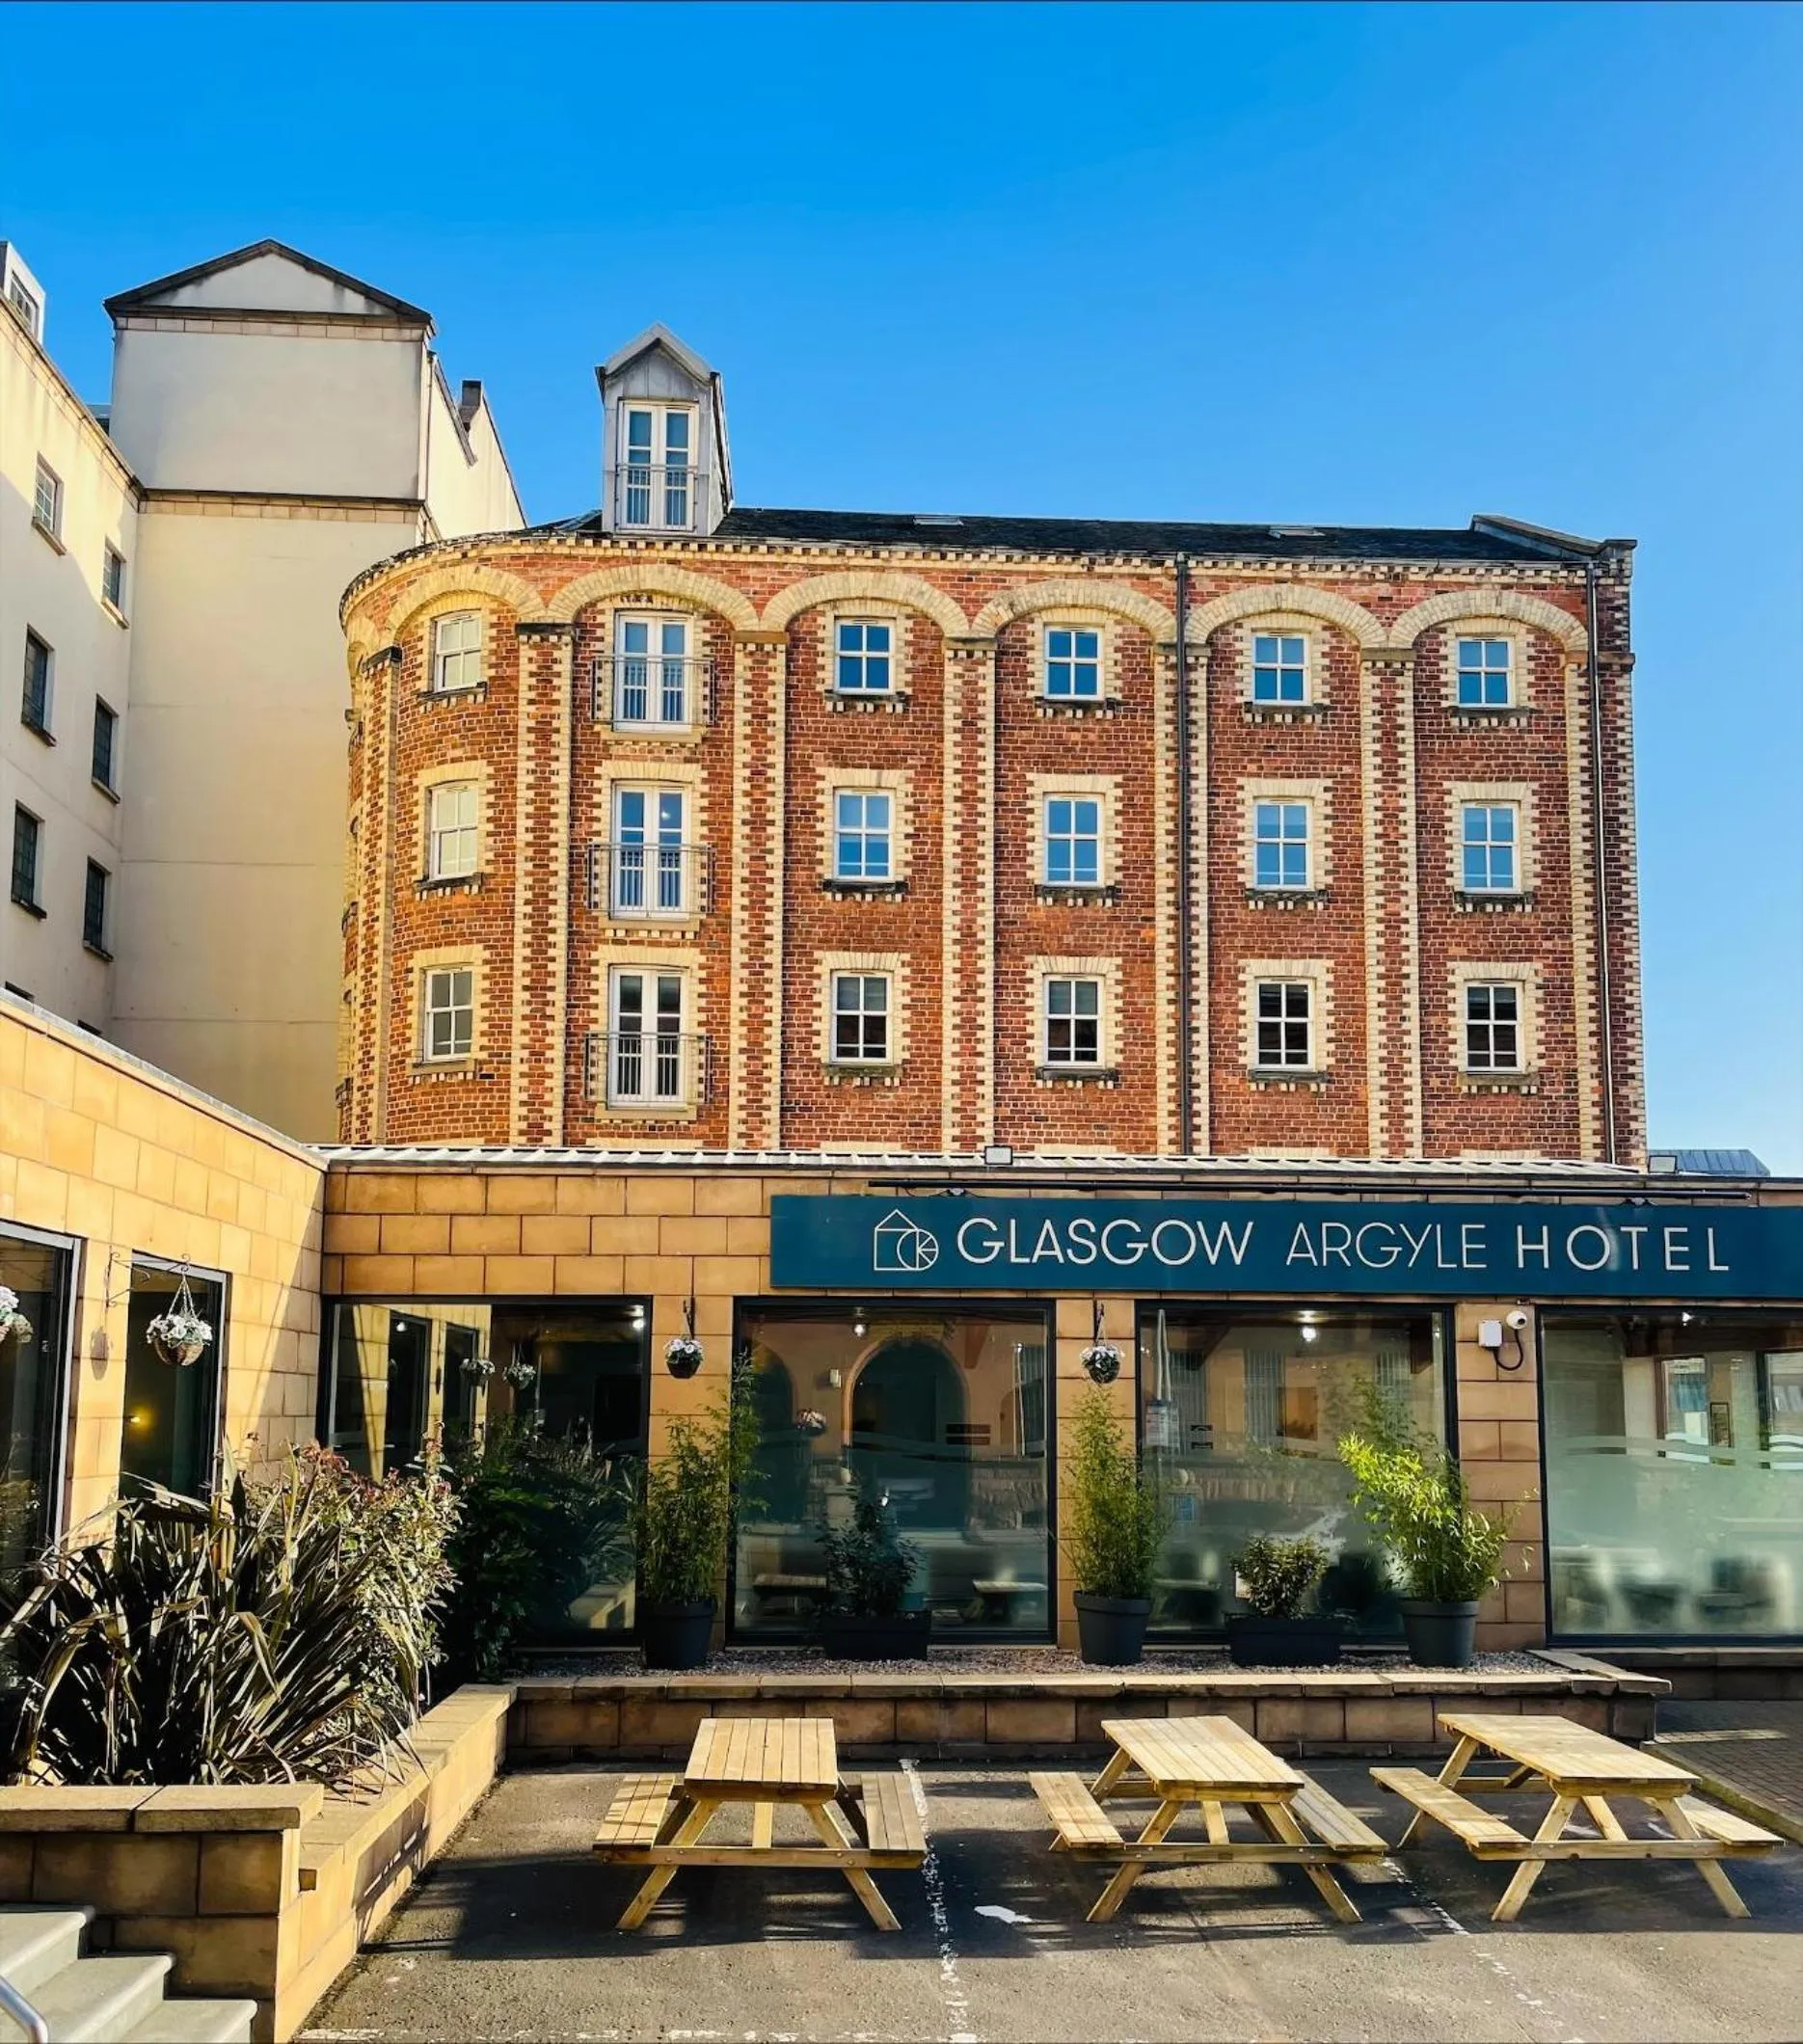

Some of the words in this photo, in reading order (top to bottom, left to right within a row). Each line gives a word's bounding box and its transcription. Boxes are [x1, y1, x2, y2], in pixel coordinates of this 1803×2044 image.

[957, 1218, 1253, 1265] GLASGOW
[1286, 1222, 1487, 1268] ARGYLE
[1517, 1224, 1729, 1271] HOTEL
